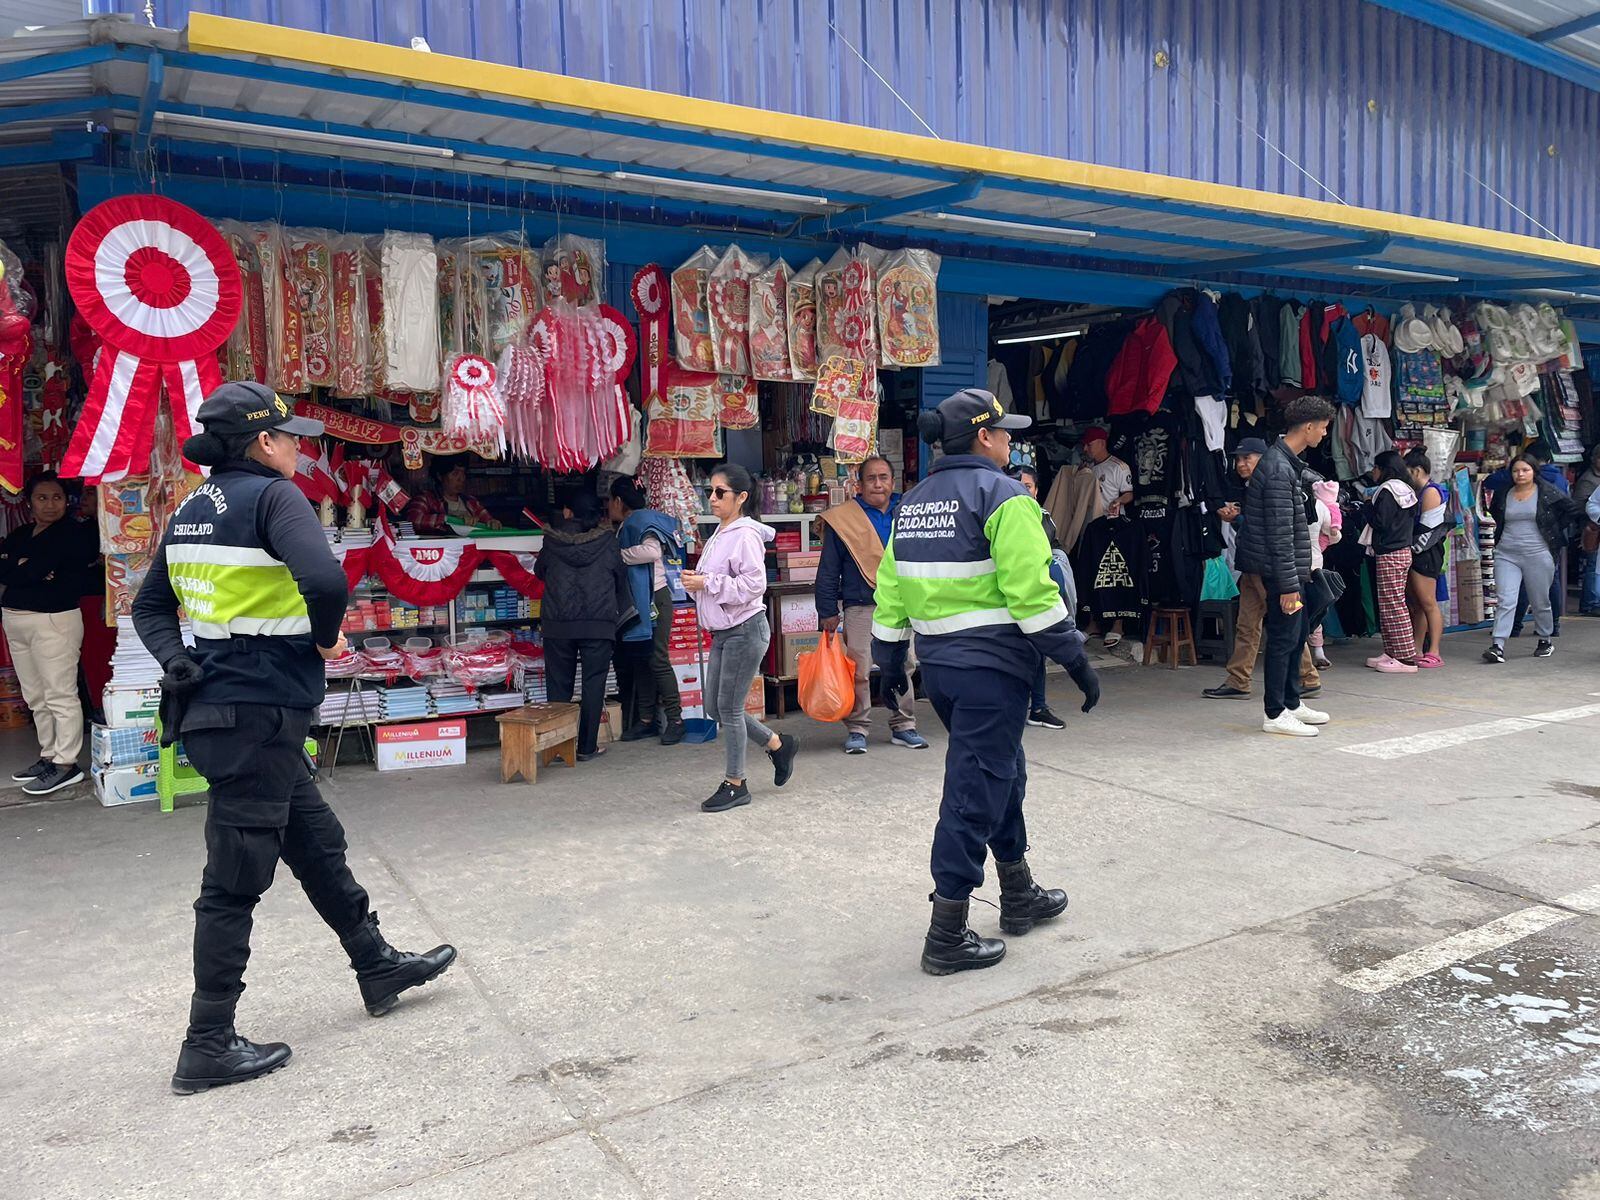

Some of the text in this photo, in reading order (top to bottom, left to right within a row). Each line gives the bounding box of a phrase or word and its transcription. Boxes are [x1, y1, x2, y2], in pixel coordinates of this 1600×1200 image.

[246, 409, 270, 420] PERU
[970, 411, 990, 425] PERU
[899, 500, 960, 517] SEGURIDAD
[897, 514, 957, 531] CIUDADANA
[173, 523, 214, 536] CHICLAYO
[415, 549, 440, 561] AMO
[383, 728, 420, 739] MILLENIUM
[395, 748, 453, 760] MILLENIUM
